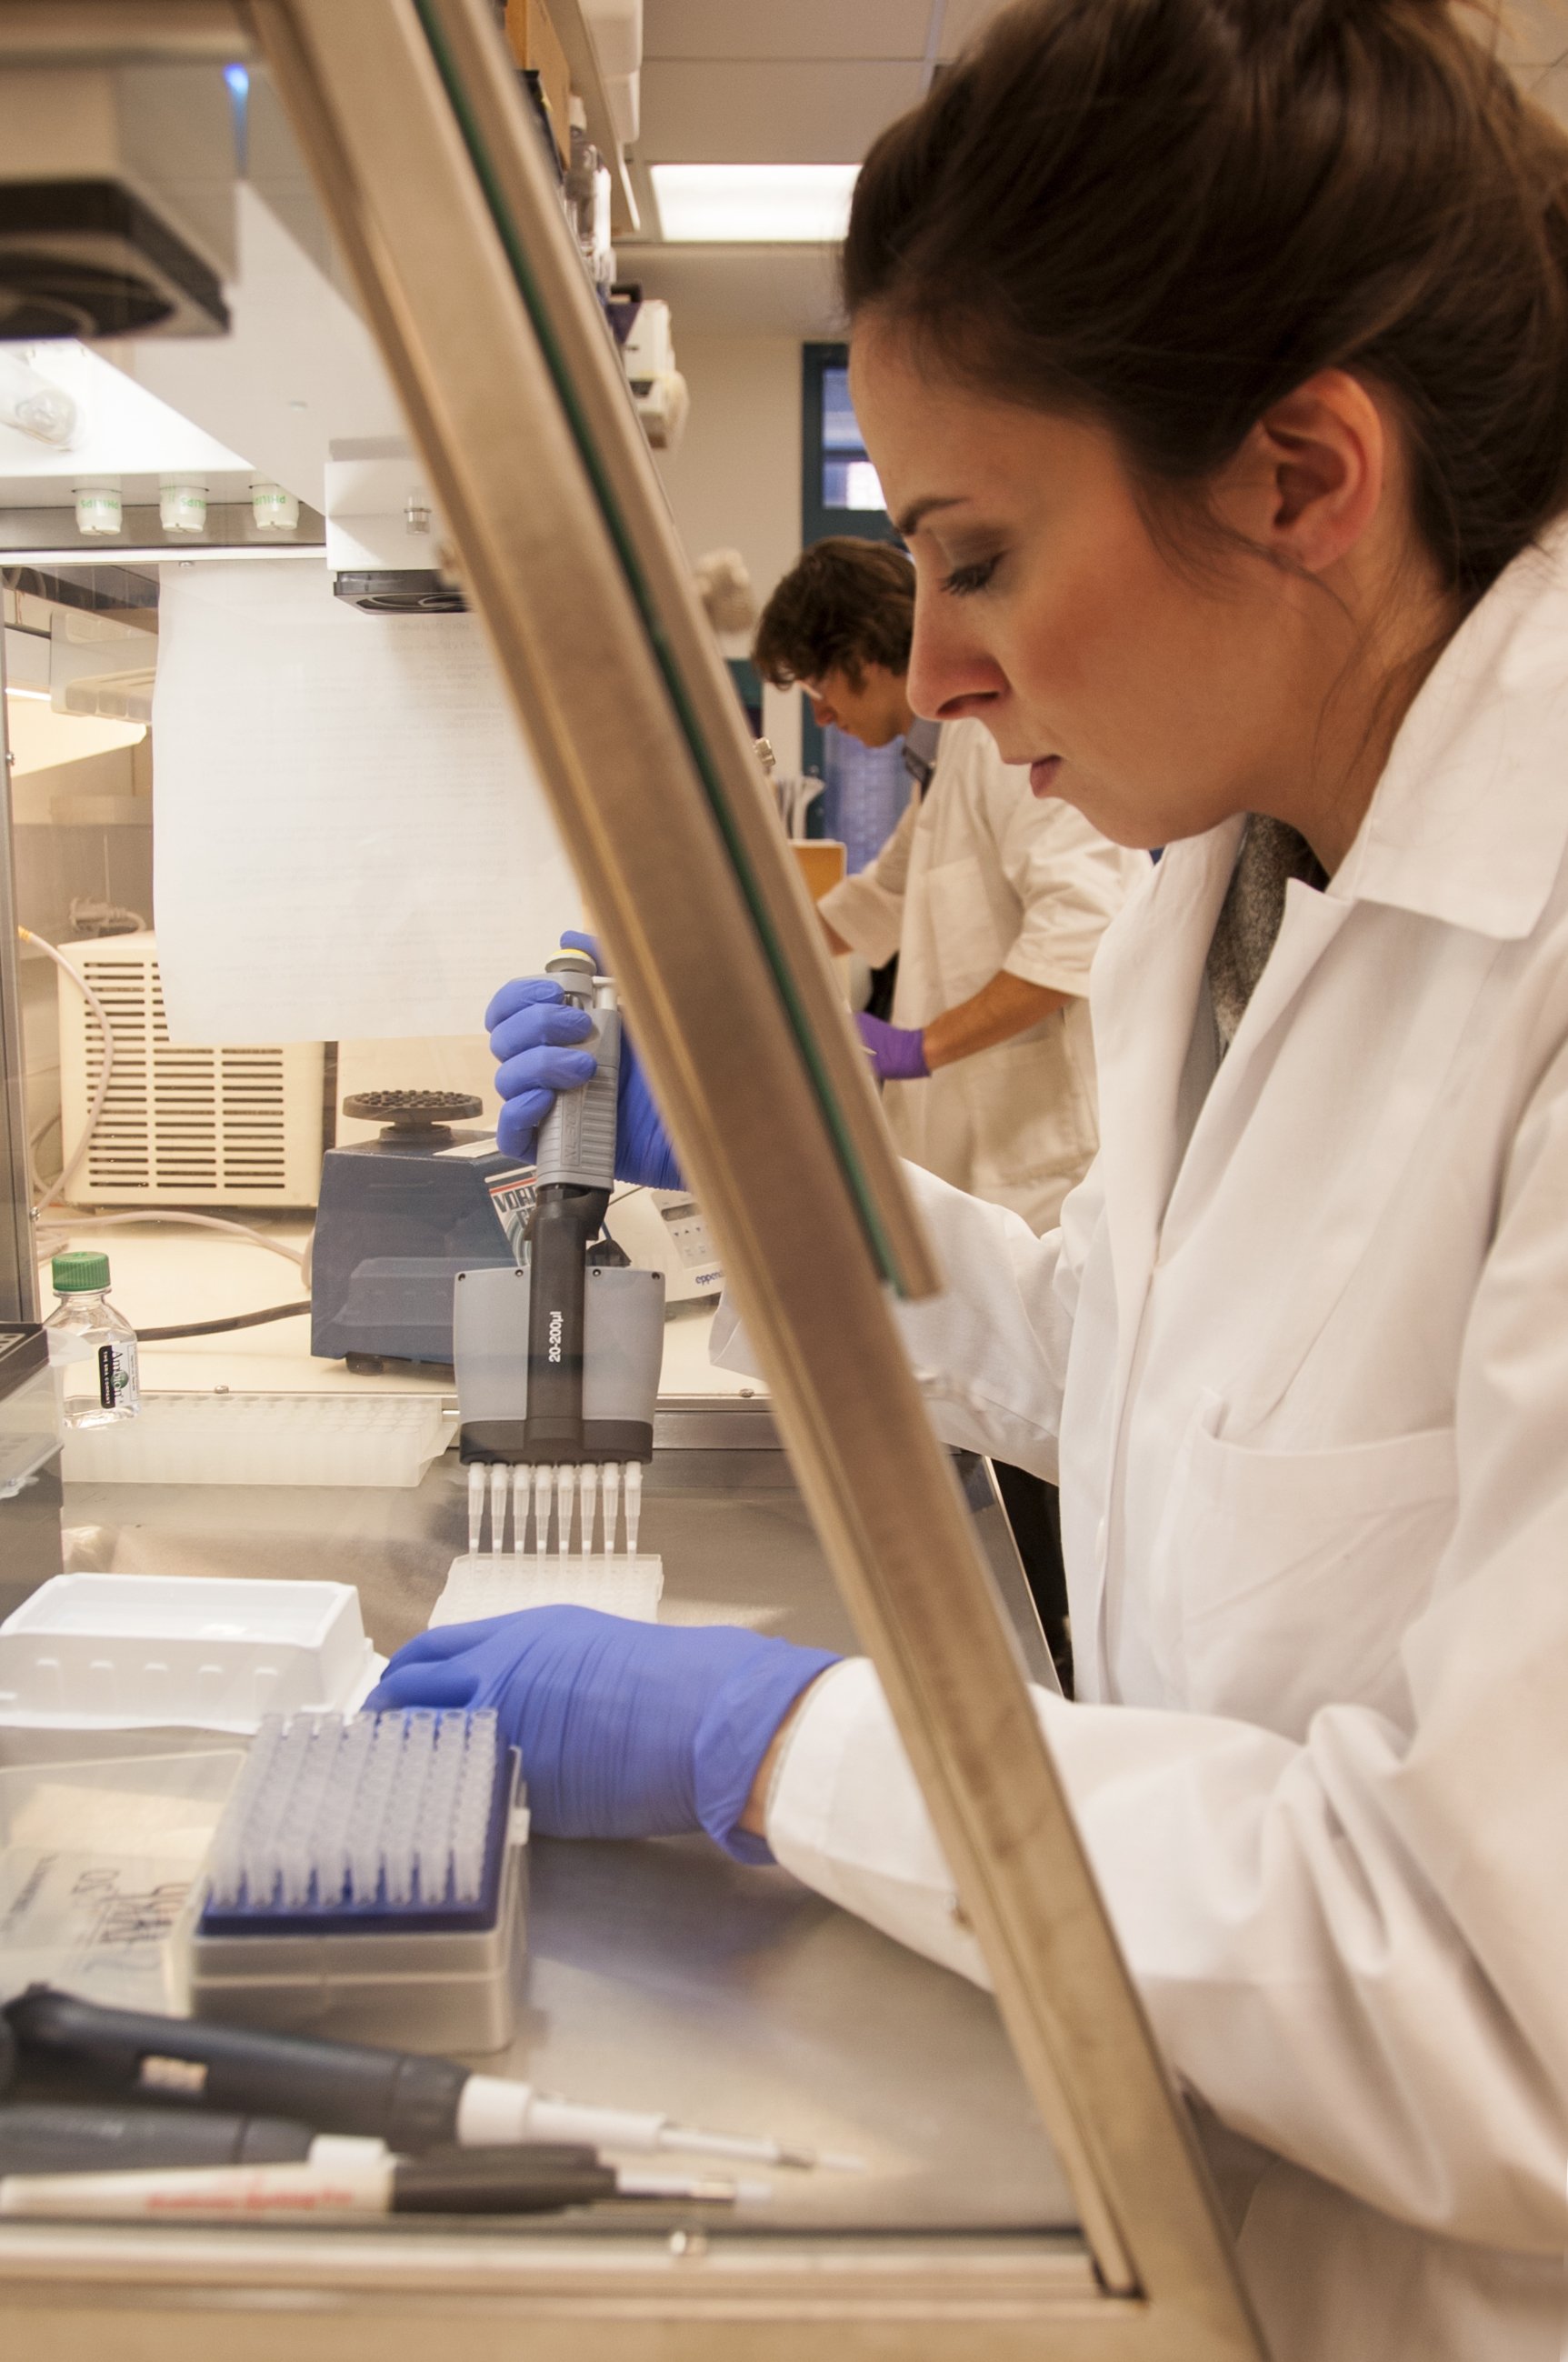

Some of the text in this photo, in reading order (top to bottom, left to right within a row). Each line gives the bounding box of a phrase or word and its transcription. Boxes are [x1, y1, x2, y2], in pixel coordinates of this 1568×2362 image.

[80, 498, 119, 510] PHILIPS
[548, 1311, 564, 1363] 20-200µl
[112, 1352, 123, 1397] Ambion
